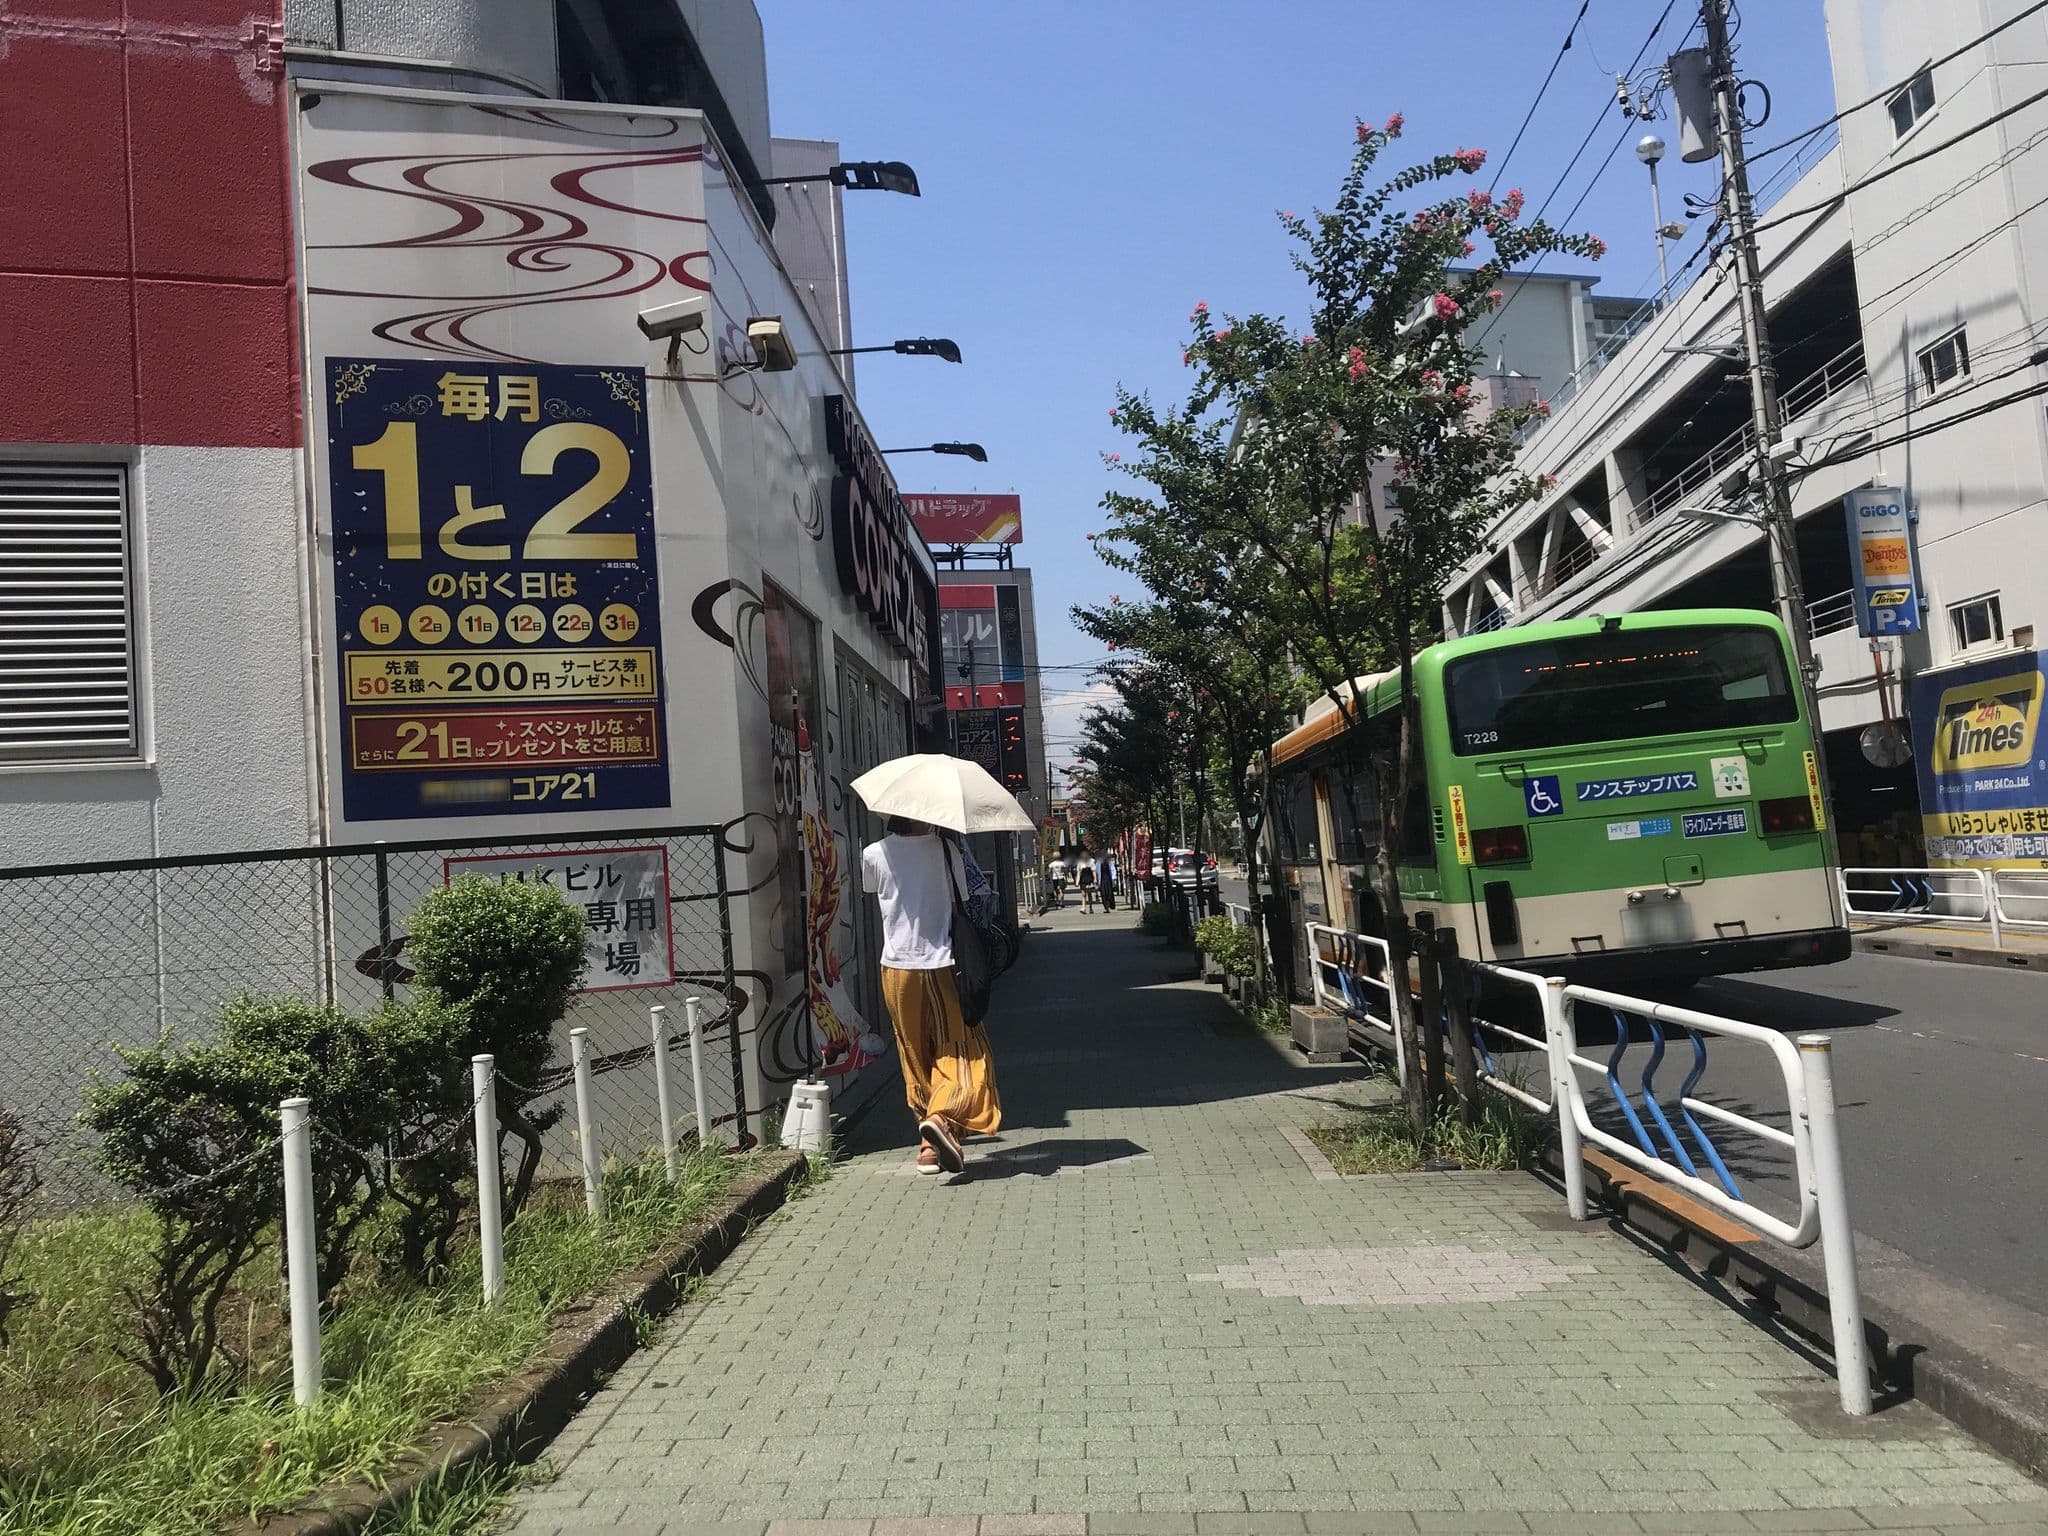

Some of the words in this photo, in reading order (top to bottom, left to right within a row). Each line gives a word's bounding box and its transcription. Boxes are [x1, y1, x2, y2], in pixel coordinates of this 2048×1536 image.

[437, 371, 541, 423] 毎月
[352, 421, 639, 560] 1と2
[905, 498, 992, 518] ハドラッグ
[1860, 504, 1900, 518] GiGO
[1863, 545, 1907, 563] Denny's
[427, 570, 578, 600] の付く日は
[370, 616, 390, 635] 1日
[418, 615, 443, 634] 2日
[465, 615, 493, 633] 11日
[510, 614, 543, 632] 12日
[556, 613, 592, 632] 22日
[604, 613, 636, 632] 31日
[1875, 608, 1897, 631] P
[384, 659, 421, 676] 先着
[560, 658, 638, 674] サービス券
[519, 717, 623, 738] スペシャルな
[1463, 731, 1498, 745] T228
[1947, 712, 2026, 761] Times
[511, 771, 598, 801] コア21
[1578, 773, 1698, 800] ノンステップバス
[1948, 809, 2048, 835] いらっしゃいませ
